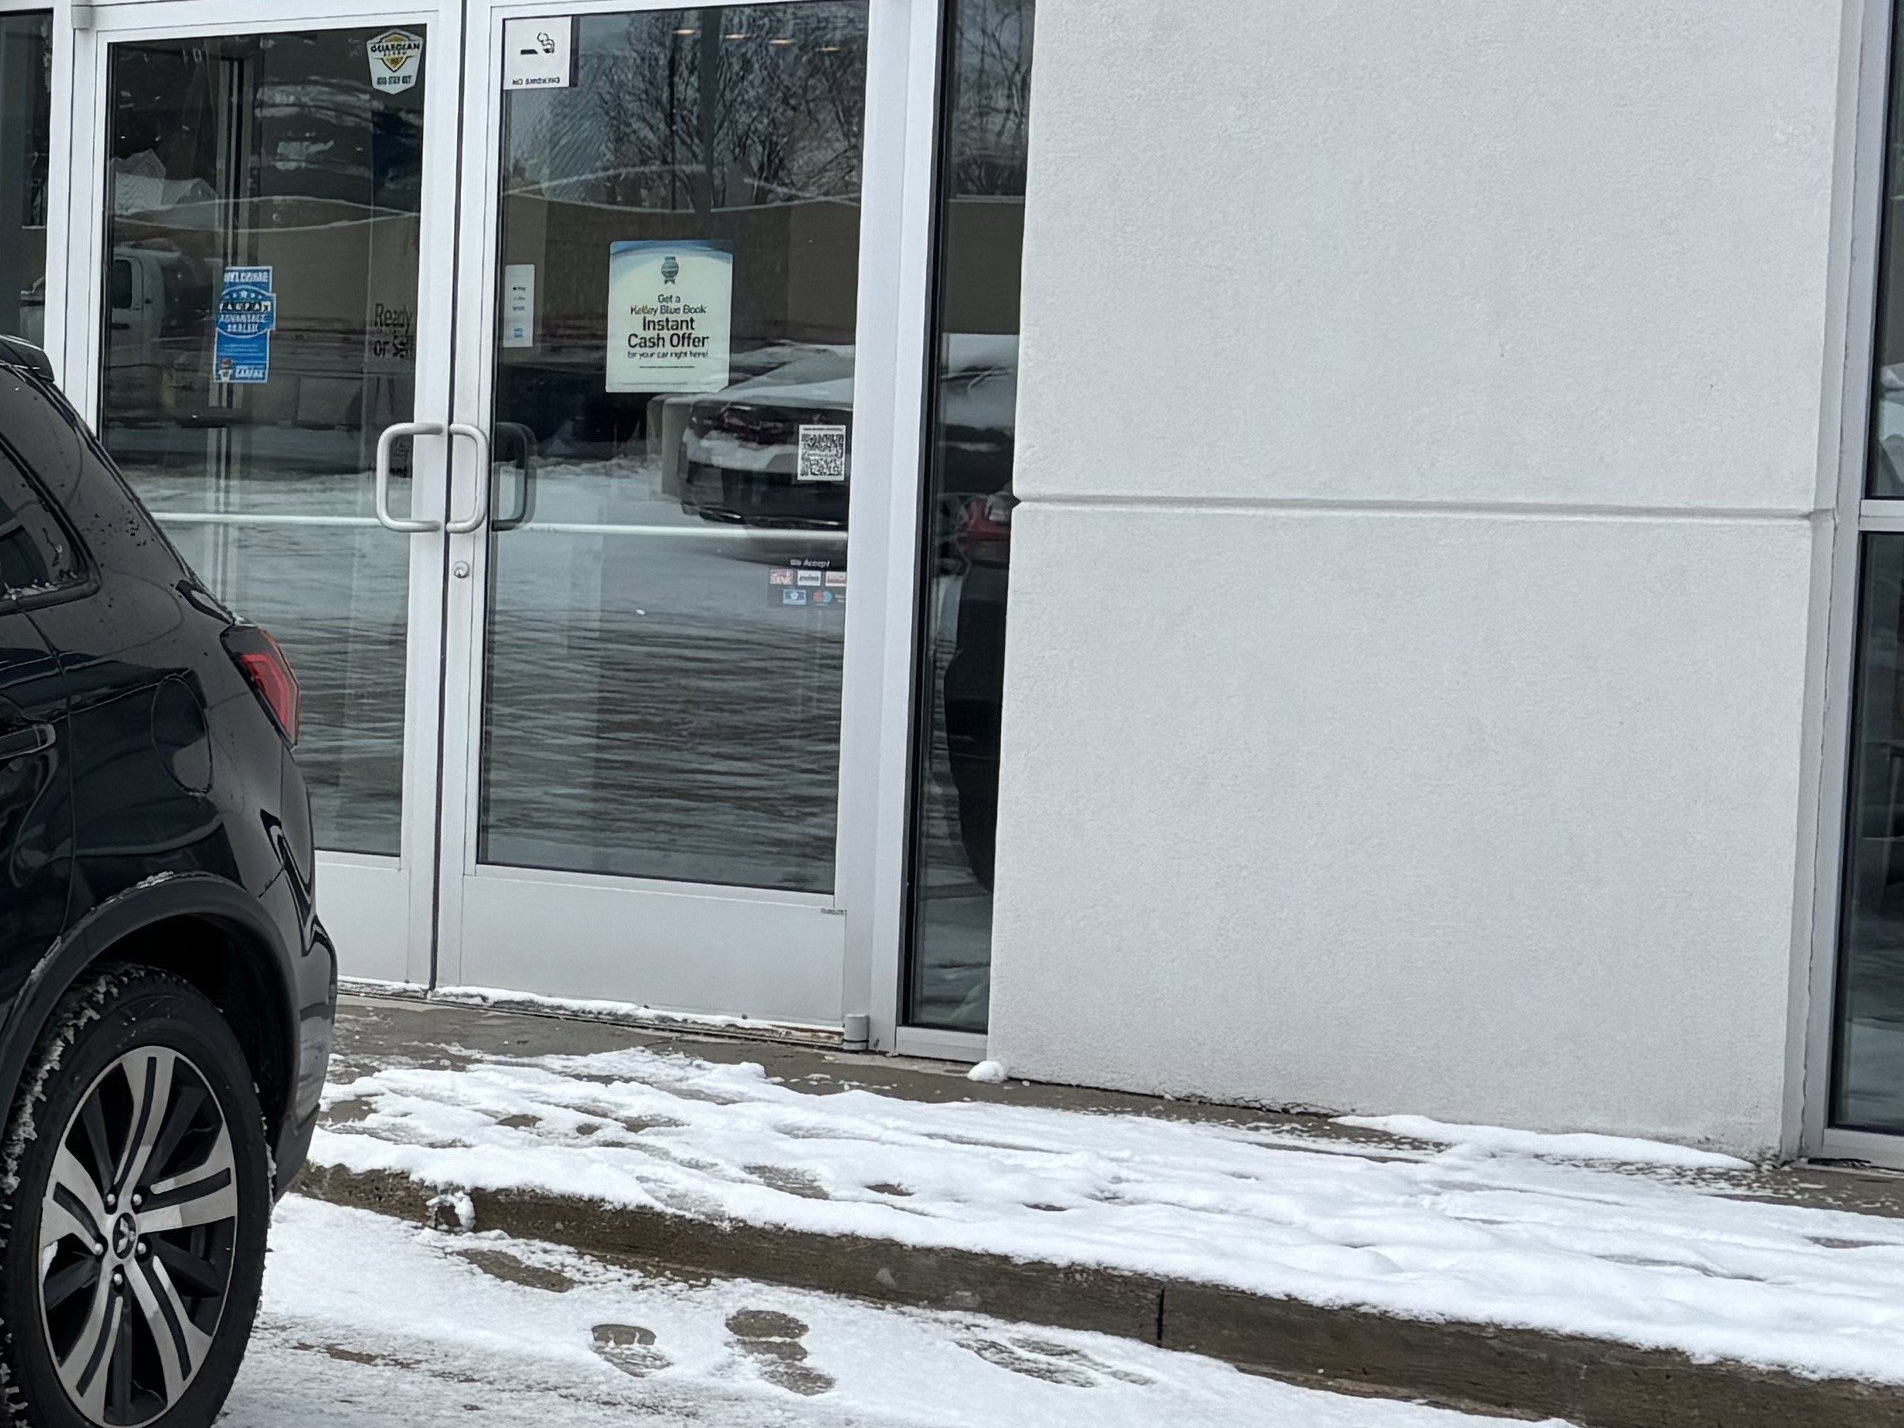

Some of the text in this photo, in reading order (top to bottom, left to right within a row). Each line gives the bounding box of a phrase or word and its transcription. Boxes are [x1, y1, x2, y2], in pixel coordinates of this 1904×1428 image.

[657, 294, 672, 303] Get
[630, 304, 707, 316] Kelley Blue Book
[643, 316, 695, 331] Instant
[627, 332, 709, 348] Cash Offer
